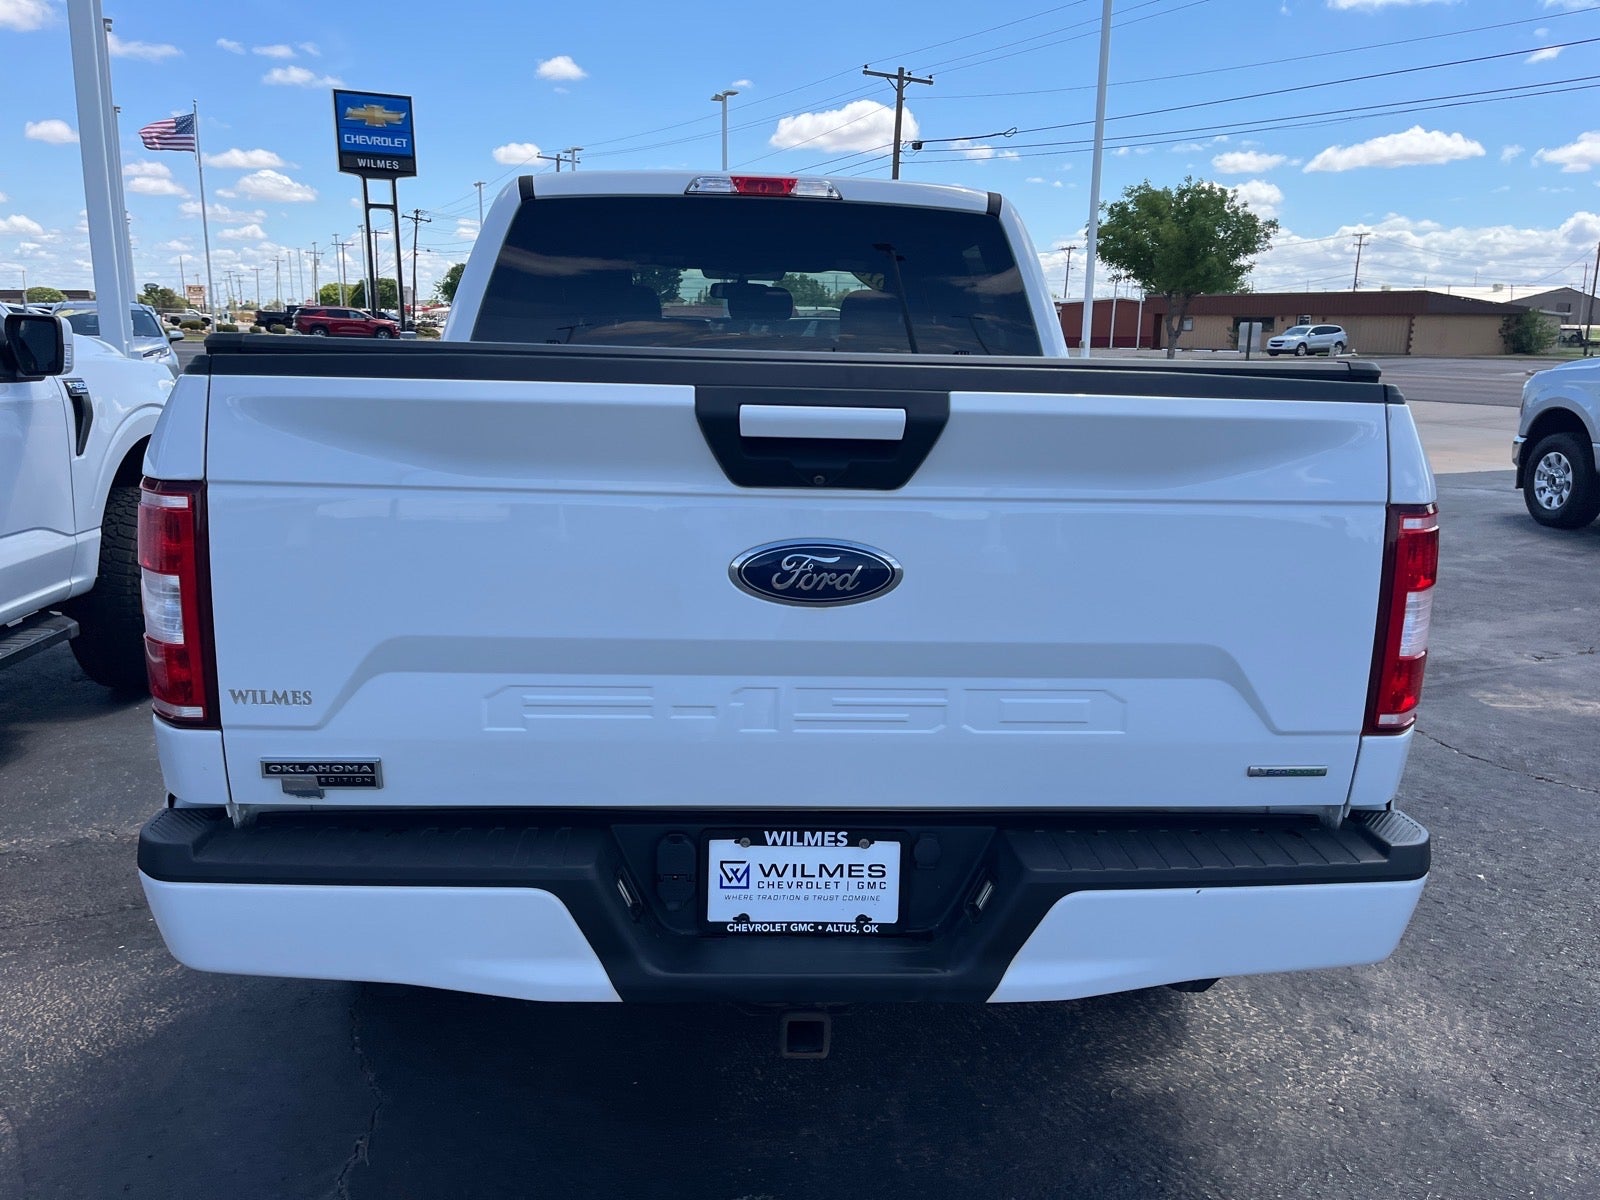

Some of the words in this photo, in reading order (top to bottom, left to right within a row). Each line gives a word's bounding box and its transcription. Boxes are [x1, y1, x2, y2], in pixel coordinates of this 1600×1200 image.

[344, 134, 408, 148] CHEVROLET
[357, 158, 399, 170] WILMES
[771, 553, 863, 591] Ford
[229, 688, 313, 706] WILMES
[482, 684, 1128, 735] F-150
[268, 764, 372, 773] OKLAHOMA
[764, 830, 849, 847] WILMES
[758, 863, 887, 878] WILMES
[757, 880, 841, 890] CHEVROLET
[857, 881, 887, 890] GMC
[842, 894, 881, 902] COMBINE
[726, 923, 787, 933] CHEVROLET
[790, 923, 815, 932] GMC
[826, 923, 860, 934] ALTUS,
[862, 924, 879, 933] OK
